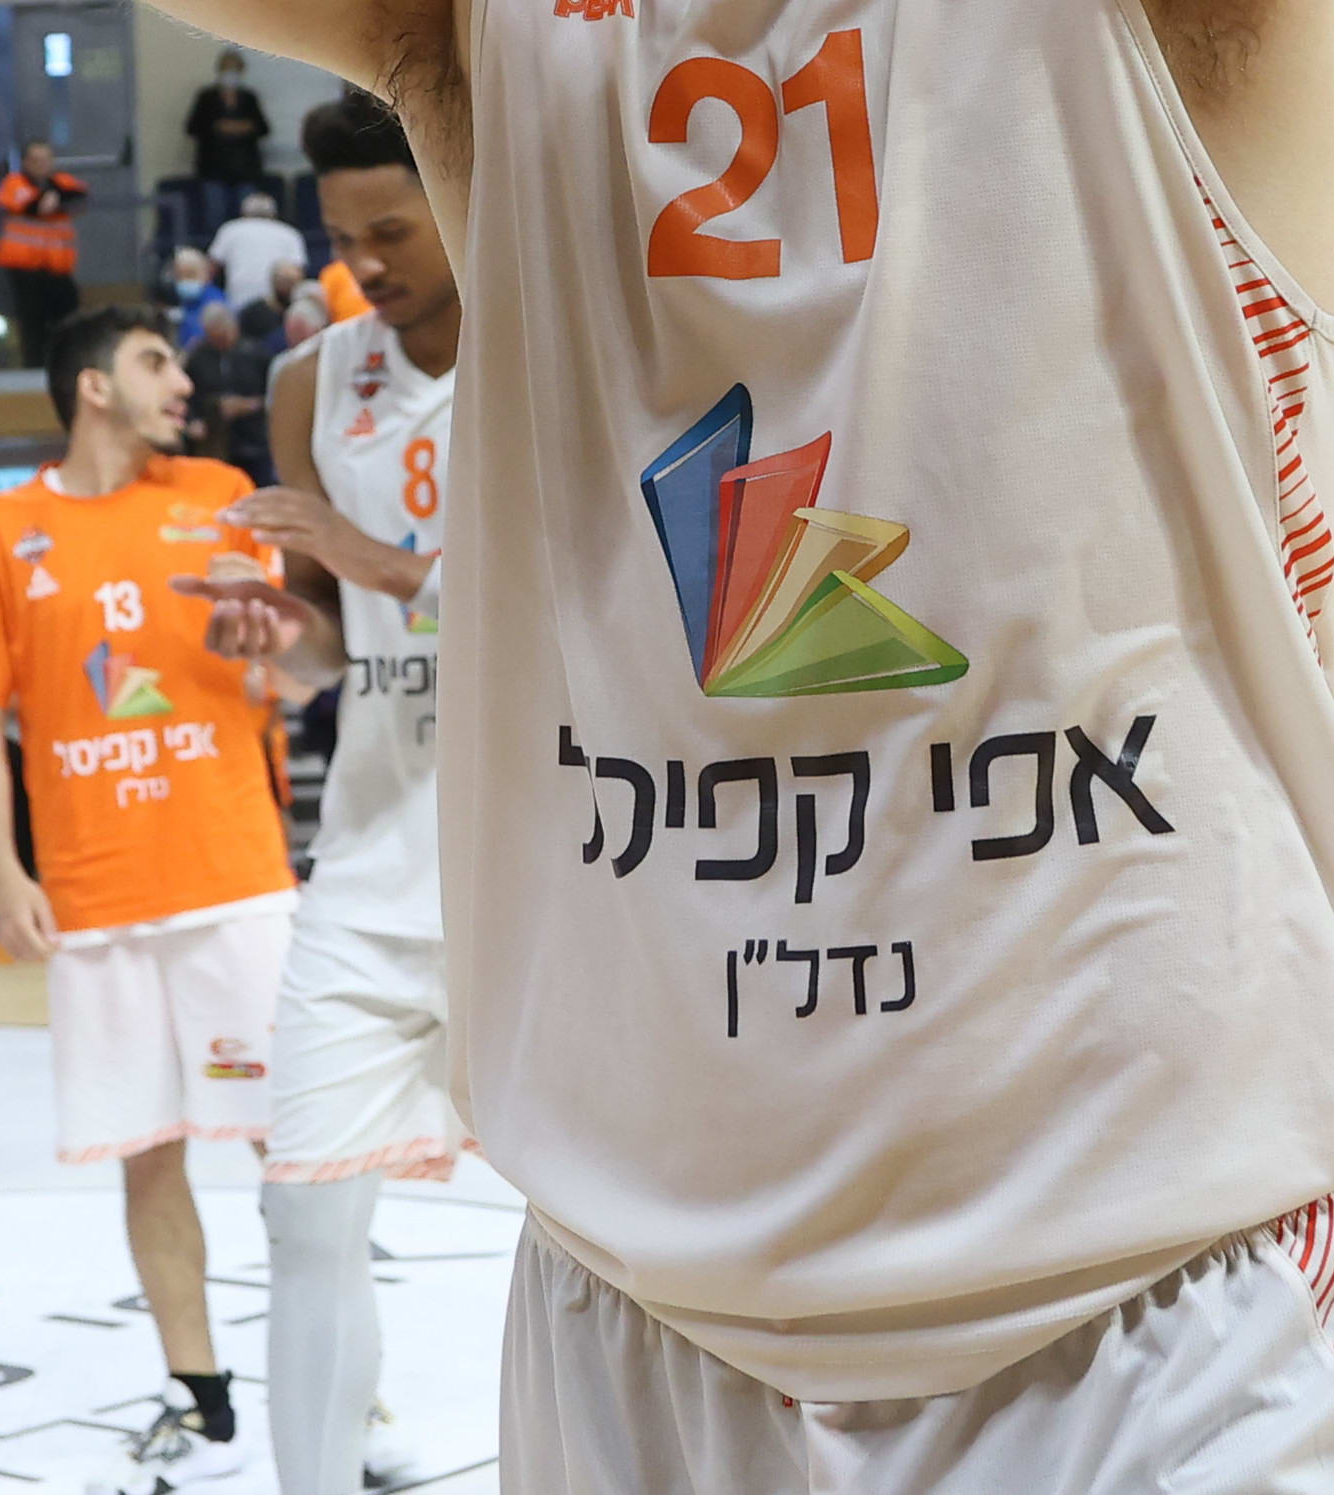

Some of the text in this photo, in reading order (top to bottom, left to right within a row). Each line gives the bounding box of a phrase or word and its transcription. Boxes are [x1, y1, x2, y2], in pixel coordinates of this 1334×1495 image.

[648, 28, 880, 280] 21
[94, 580, 144, 632] 13
[930, 714, 1176, 862] אפי
